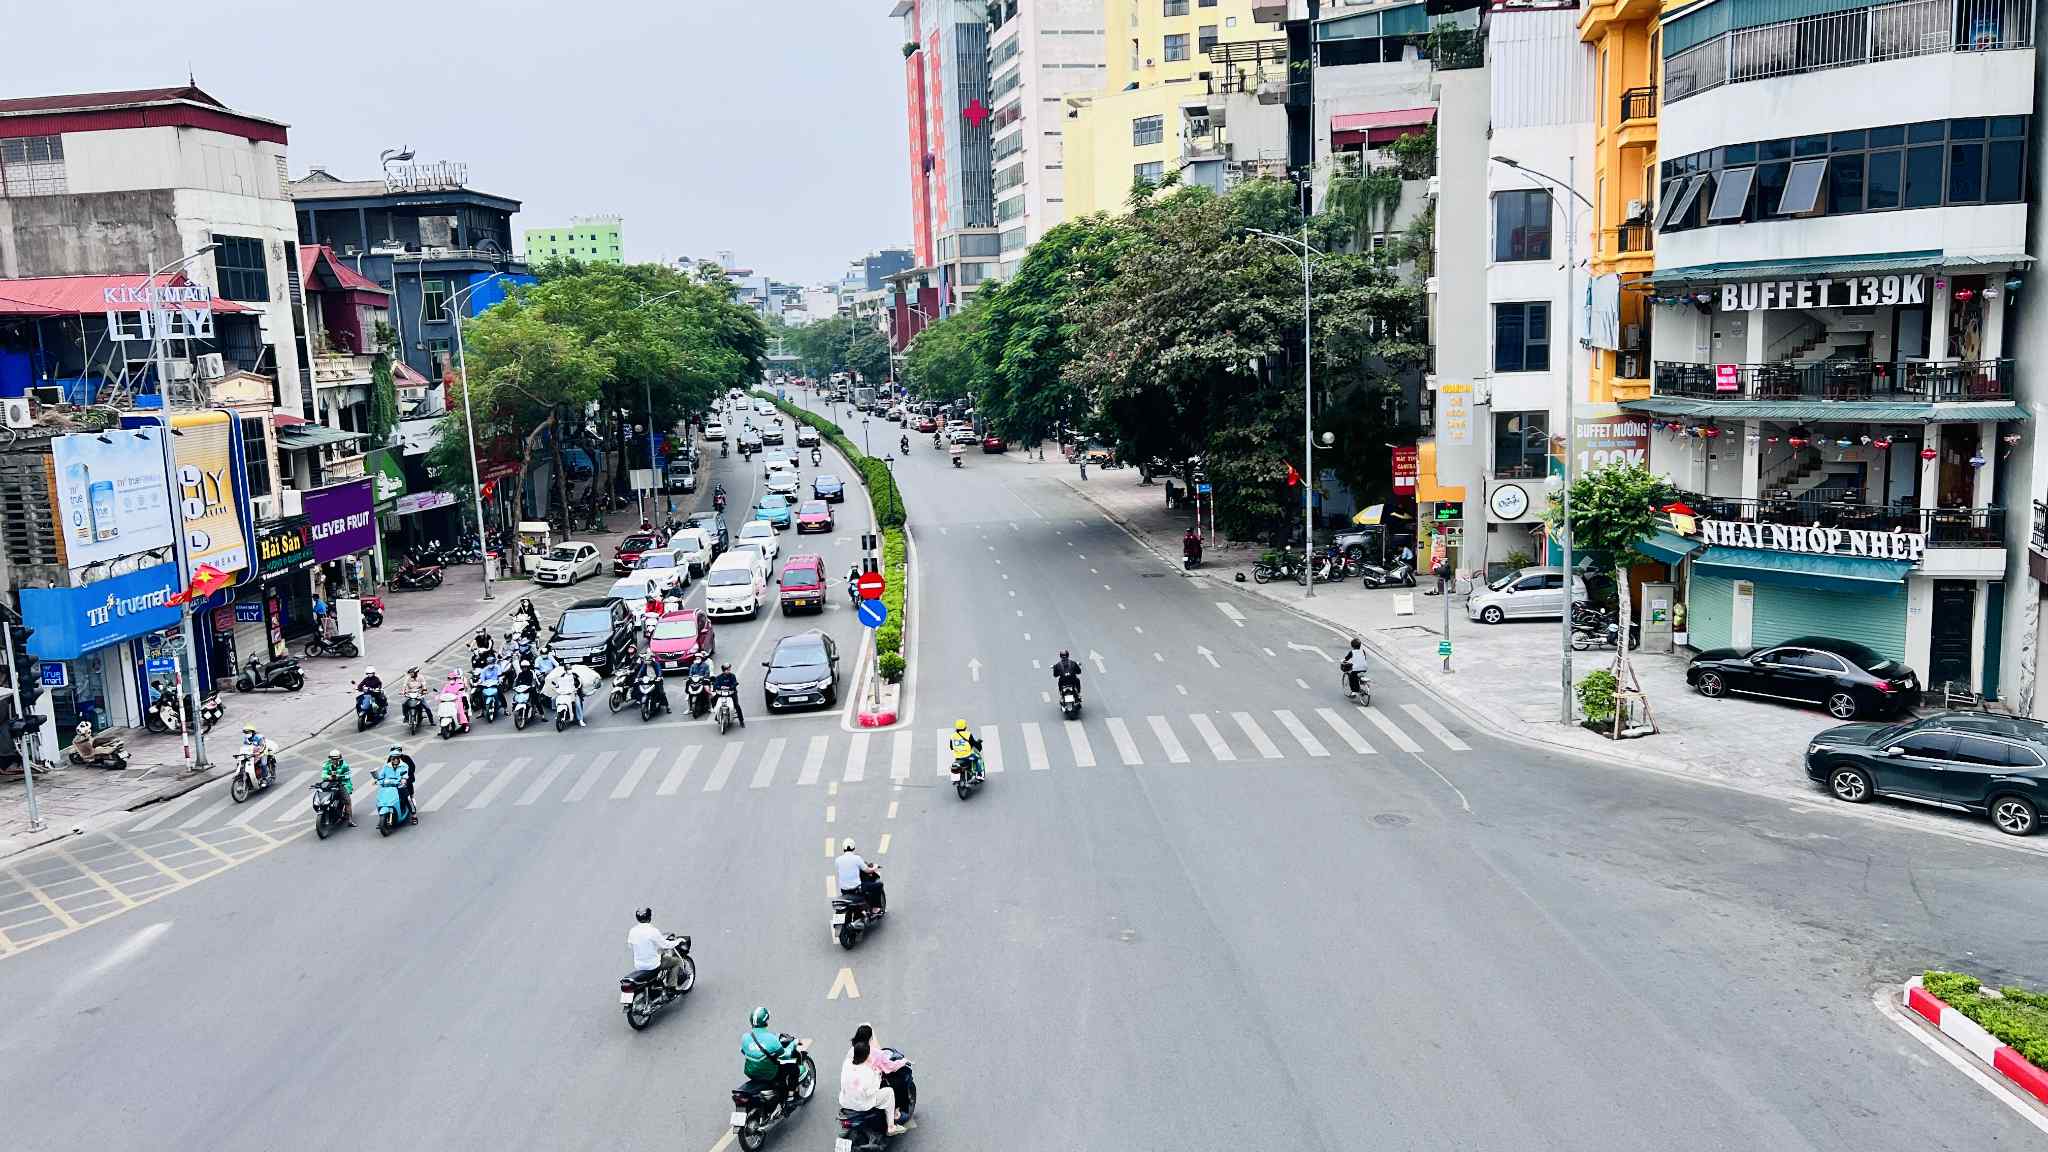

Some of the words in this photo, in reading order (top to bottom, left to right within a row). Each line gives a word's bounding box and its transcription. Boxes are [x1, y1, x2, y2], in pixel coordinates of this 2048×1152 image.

[1721, 279, 1832, 312] BUFFET
[1845, 274, 1924, 307] 139K
[1576, 423, 1611, 438] BUFFET
[312, 518, 346, 541] KLEVER
[347, 510, 370, 530] FRUIT
[1701, 520, 1764, 548] NHAI
[1771, 520, 1842, 554] NHÓP
[1850, 525, 1926, 561] NHÉP
[87, 605, 110, 627] TH
[236, 611, 260, 621] LILY
[43, 671, 61, 679] true
